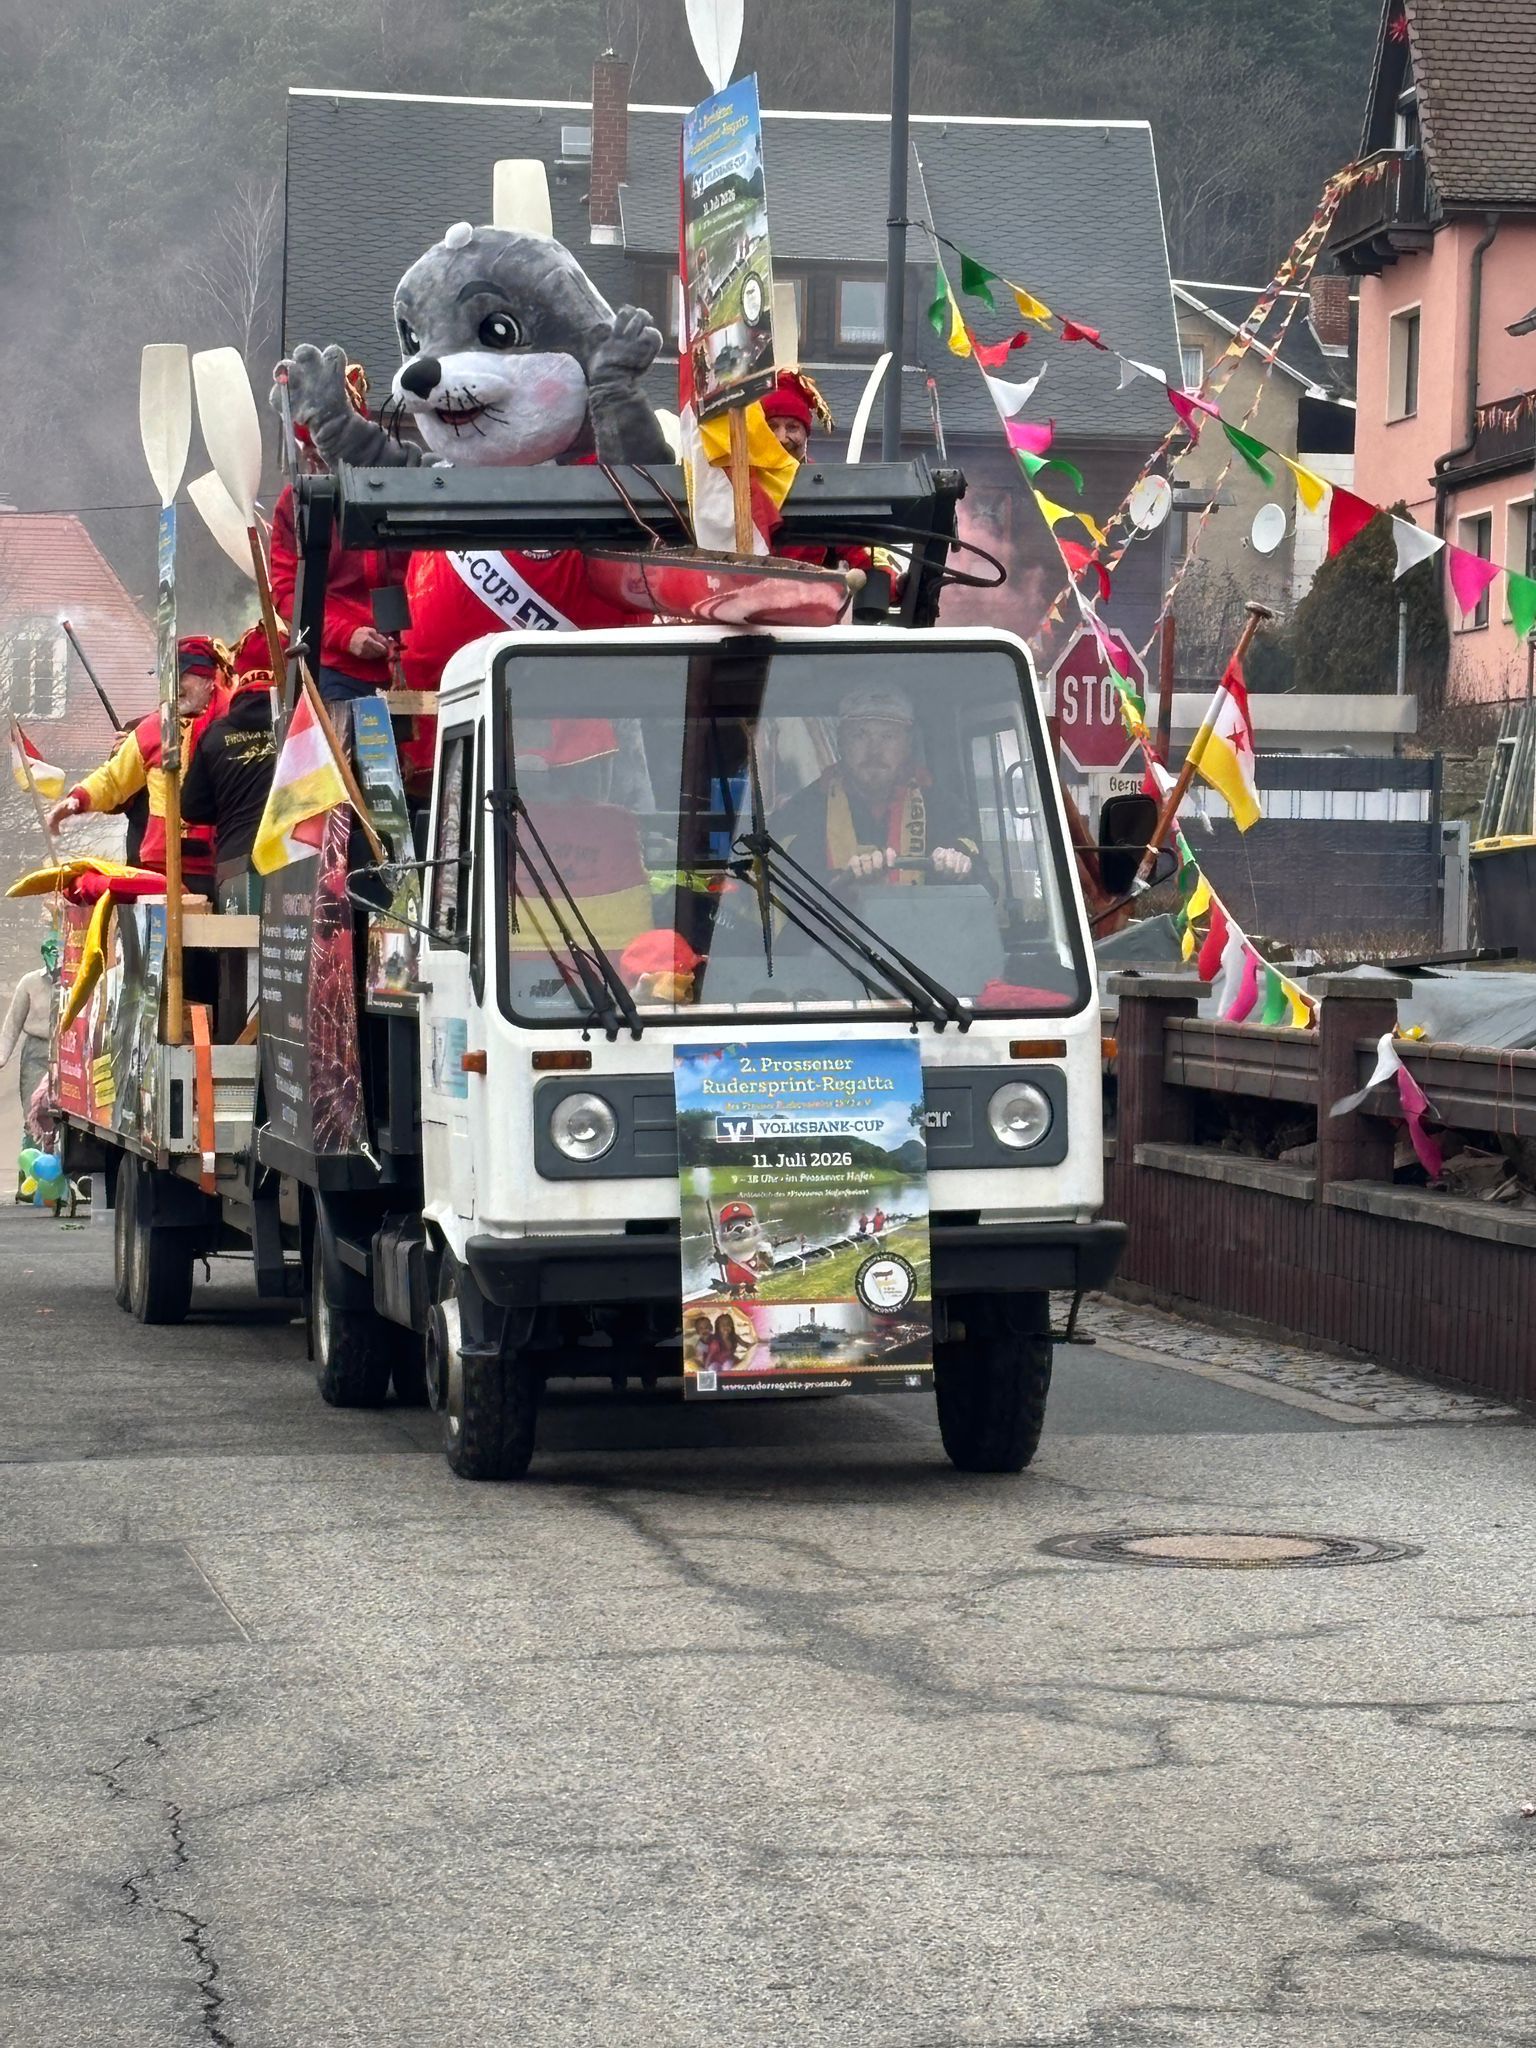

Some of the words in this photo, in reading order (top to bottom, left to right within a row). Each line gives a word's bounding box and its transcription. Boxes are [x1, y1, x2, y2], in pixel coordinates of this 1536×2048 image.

[1109, 776, 1143, 792] Bergs
[740, 1058, 757, 1073] 2.
[761, 1057, 853, 1073] Prossener
[703, 1076, 894, 1097] Rudersprint-Regatta
[759, 1120, 885, 1135] VOLKSBANK-CUP
[752, 1154, 773, 1168] 11.
[776, 1153, 806, 1168] Juli
[810, 1152, 852, 1167] 2026
[761, 1174, 779, 1184] Uhr
[785, 1174, 798, 1183] im
[847, 1171, 875, 1183] Hafen
